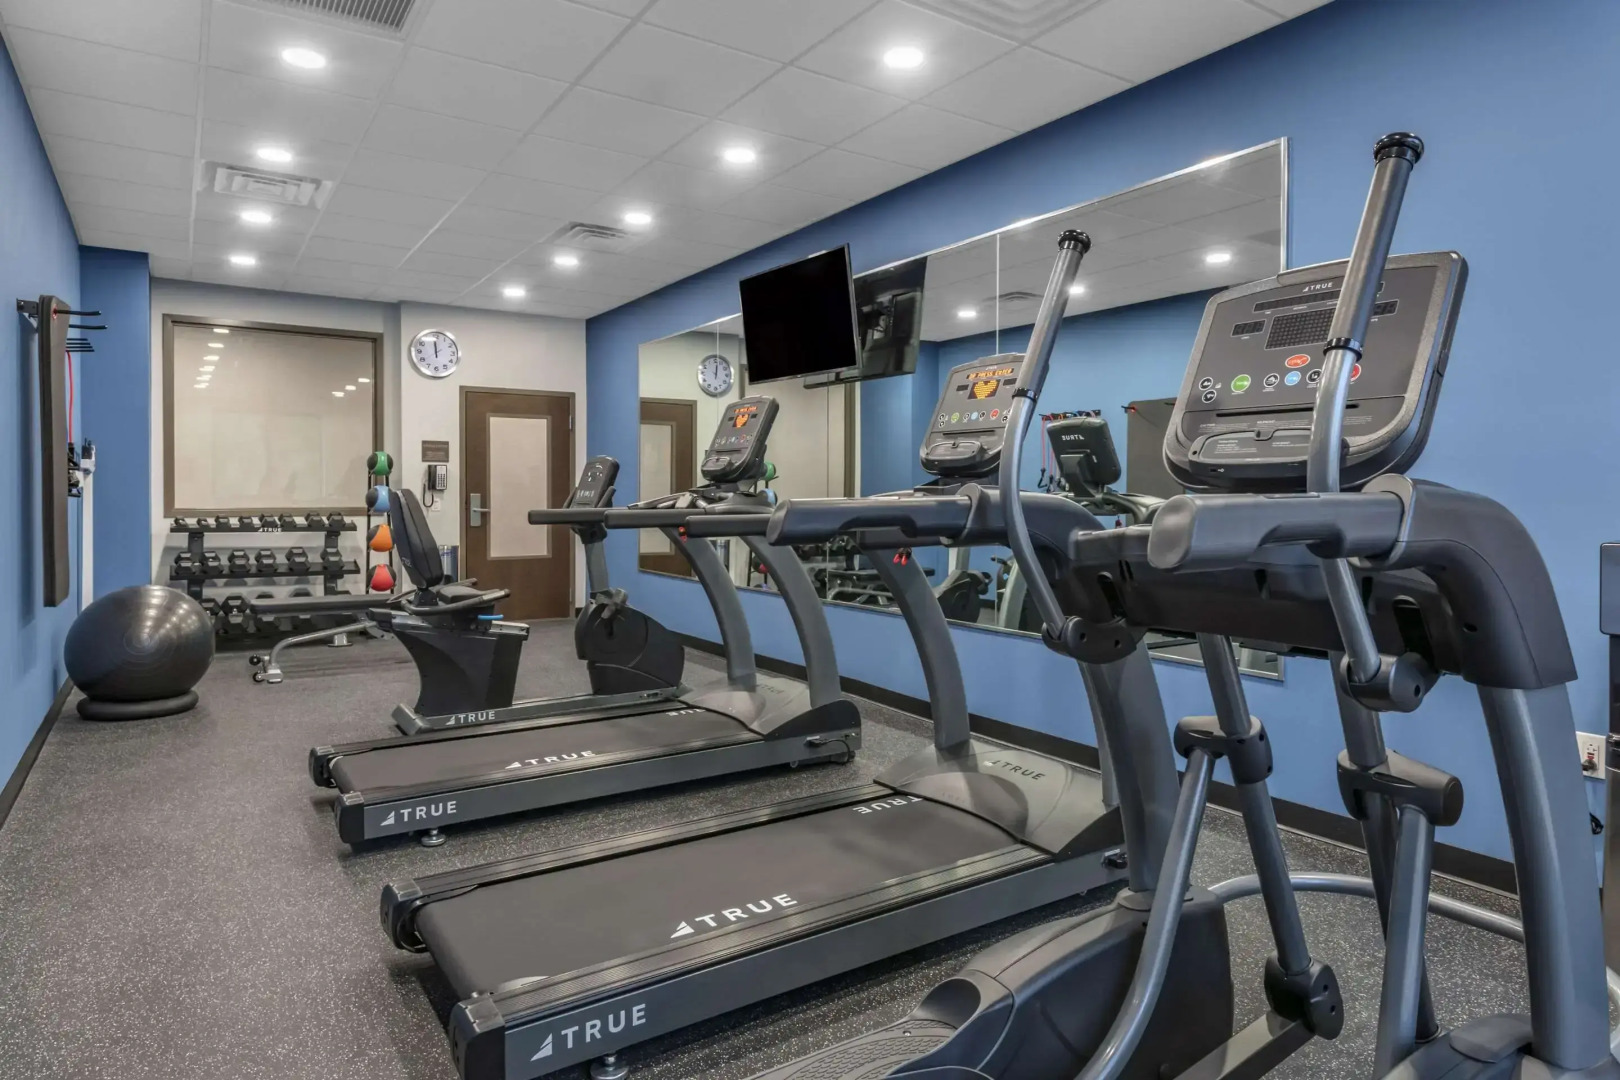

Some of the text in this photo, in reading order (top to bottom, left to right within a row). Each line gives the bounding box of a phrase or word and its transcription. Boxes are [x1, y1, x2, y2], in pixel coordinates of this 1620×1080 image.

[1309, 282, 1333, 290] TRUE
[458, 711, 496, 723] TRUE
[525, 750, 596, 766] TRUE
[1002, 761, 1046, 781] TRUE
[400, 801, 457, 822] TRUE
[852, 795, 923, 814] TRUE
[694, 893, 798, 927] TRUE
[561, 1003, 647, 1049] TRUE
